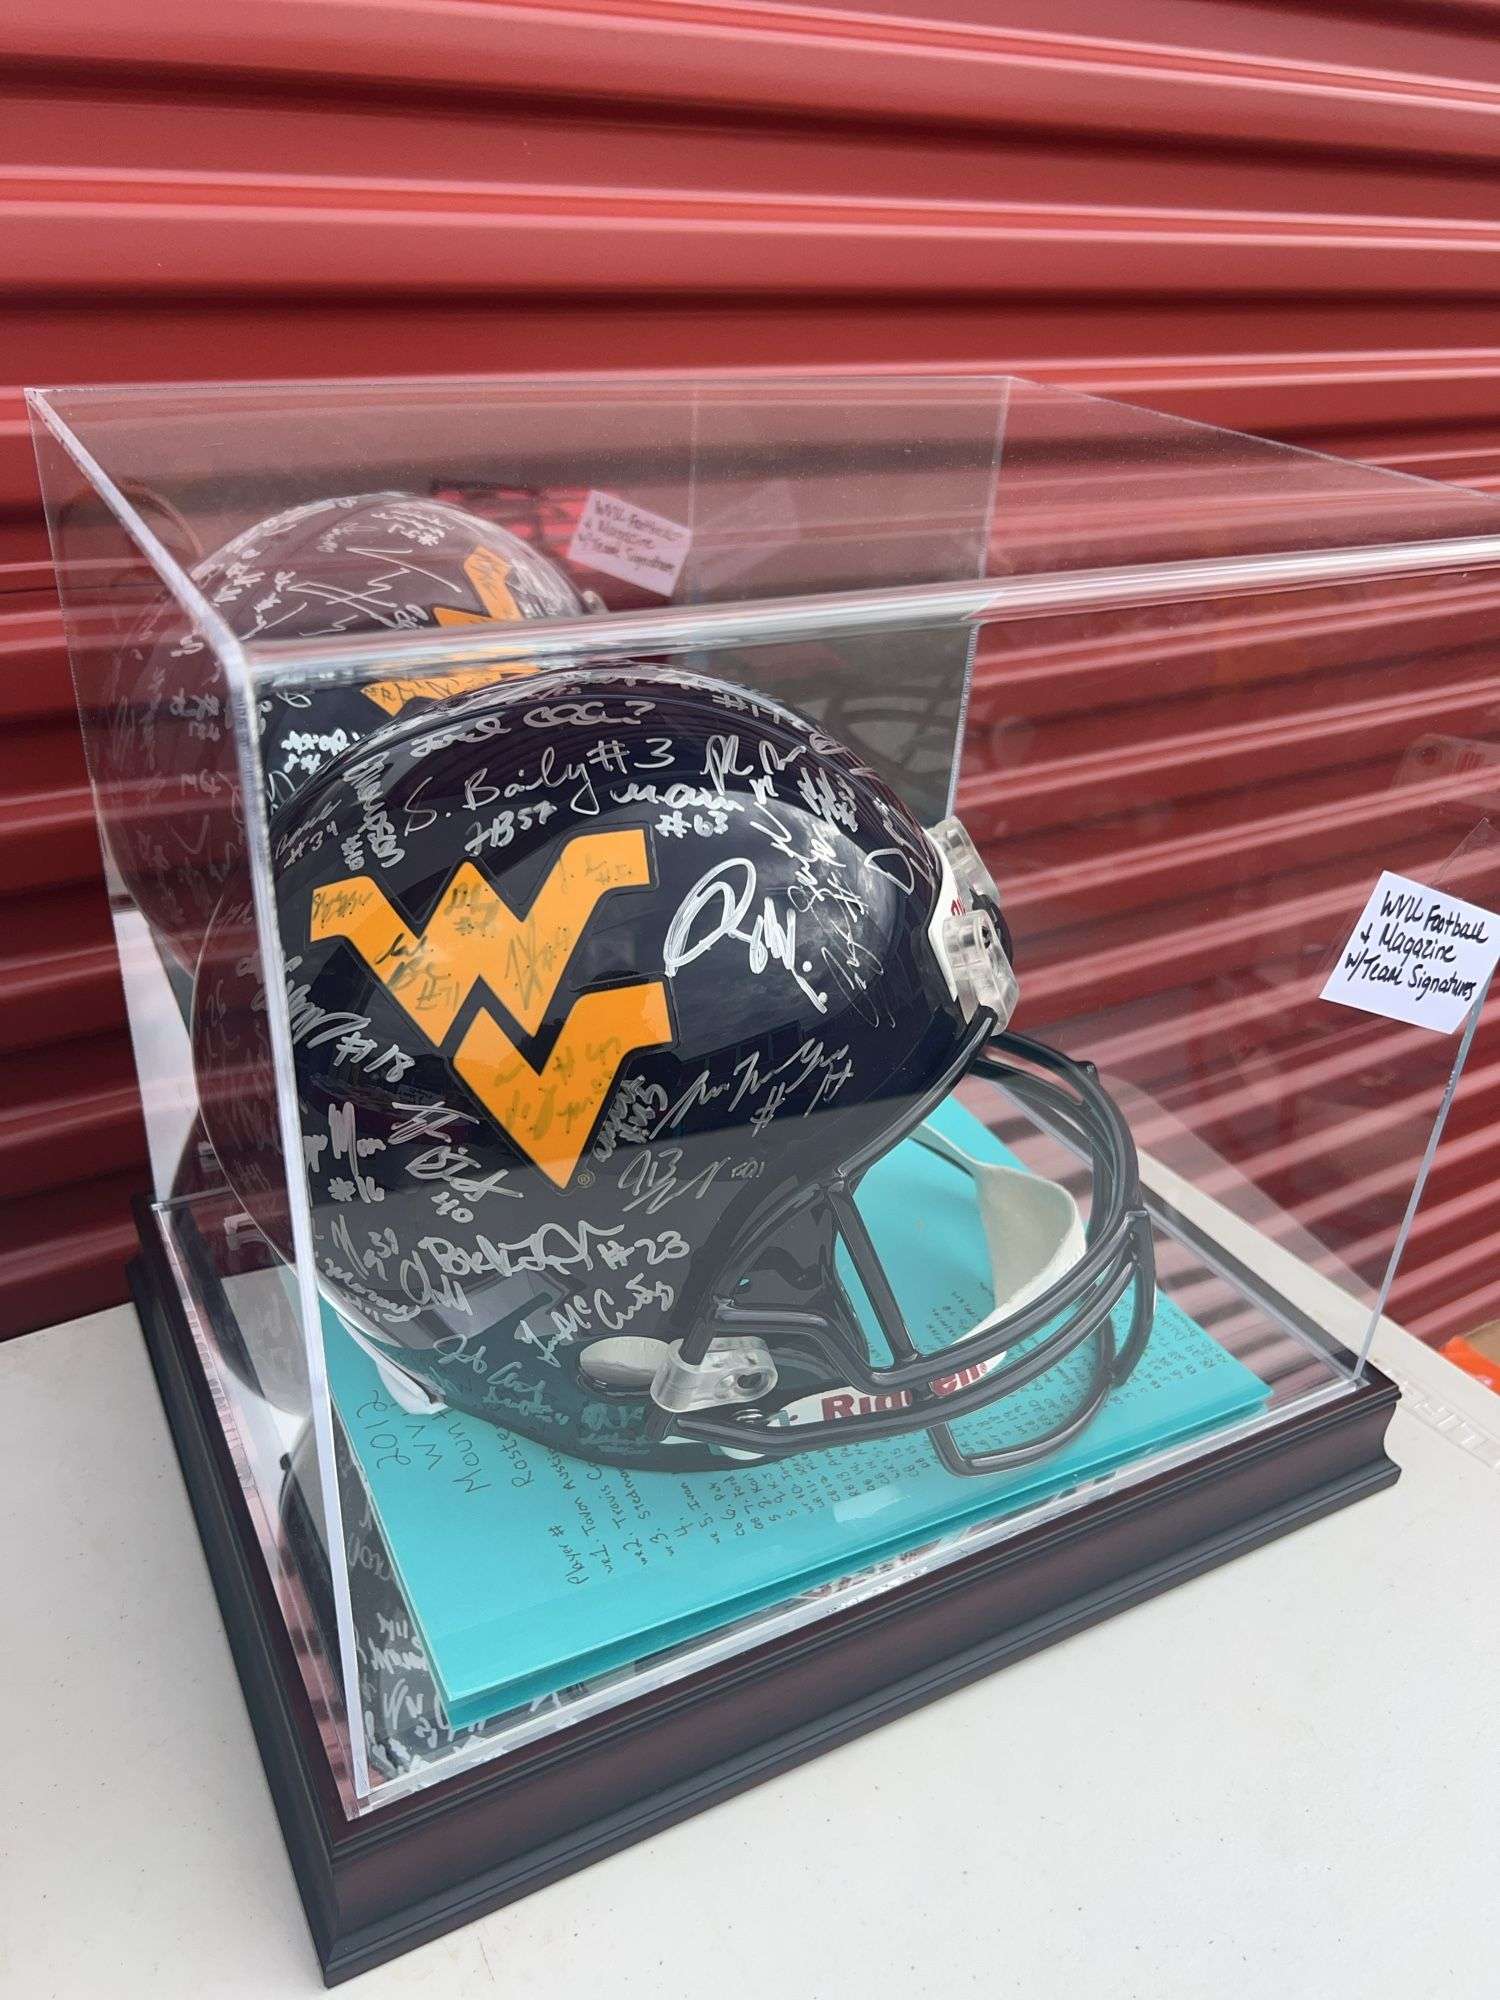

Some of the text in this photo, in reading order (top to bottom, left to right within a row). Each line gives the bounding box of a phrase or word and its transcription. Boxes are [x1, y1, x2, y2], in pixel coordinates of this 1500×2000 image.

[1378, 922, 1457, 966] Magazine
[1423, 904, 1489, 944] Football
[356, 1390, 412, 1470] 2012
[496, 1427, 535, 1488] Roste
[574, 1497, 597, 1537] Tavon
[598, 1484, 627, 1529] Travis
[559, 1544, 590, 1584] Player
